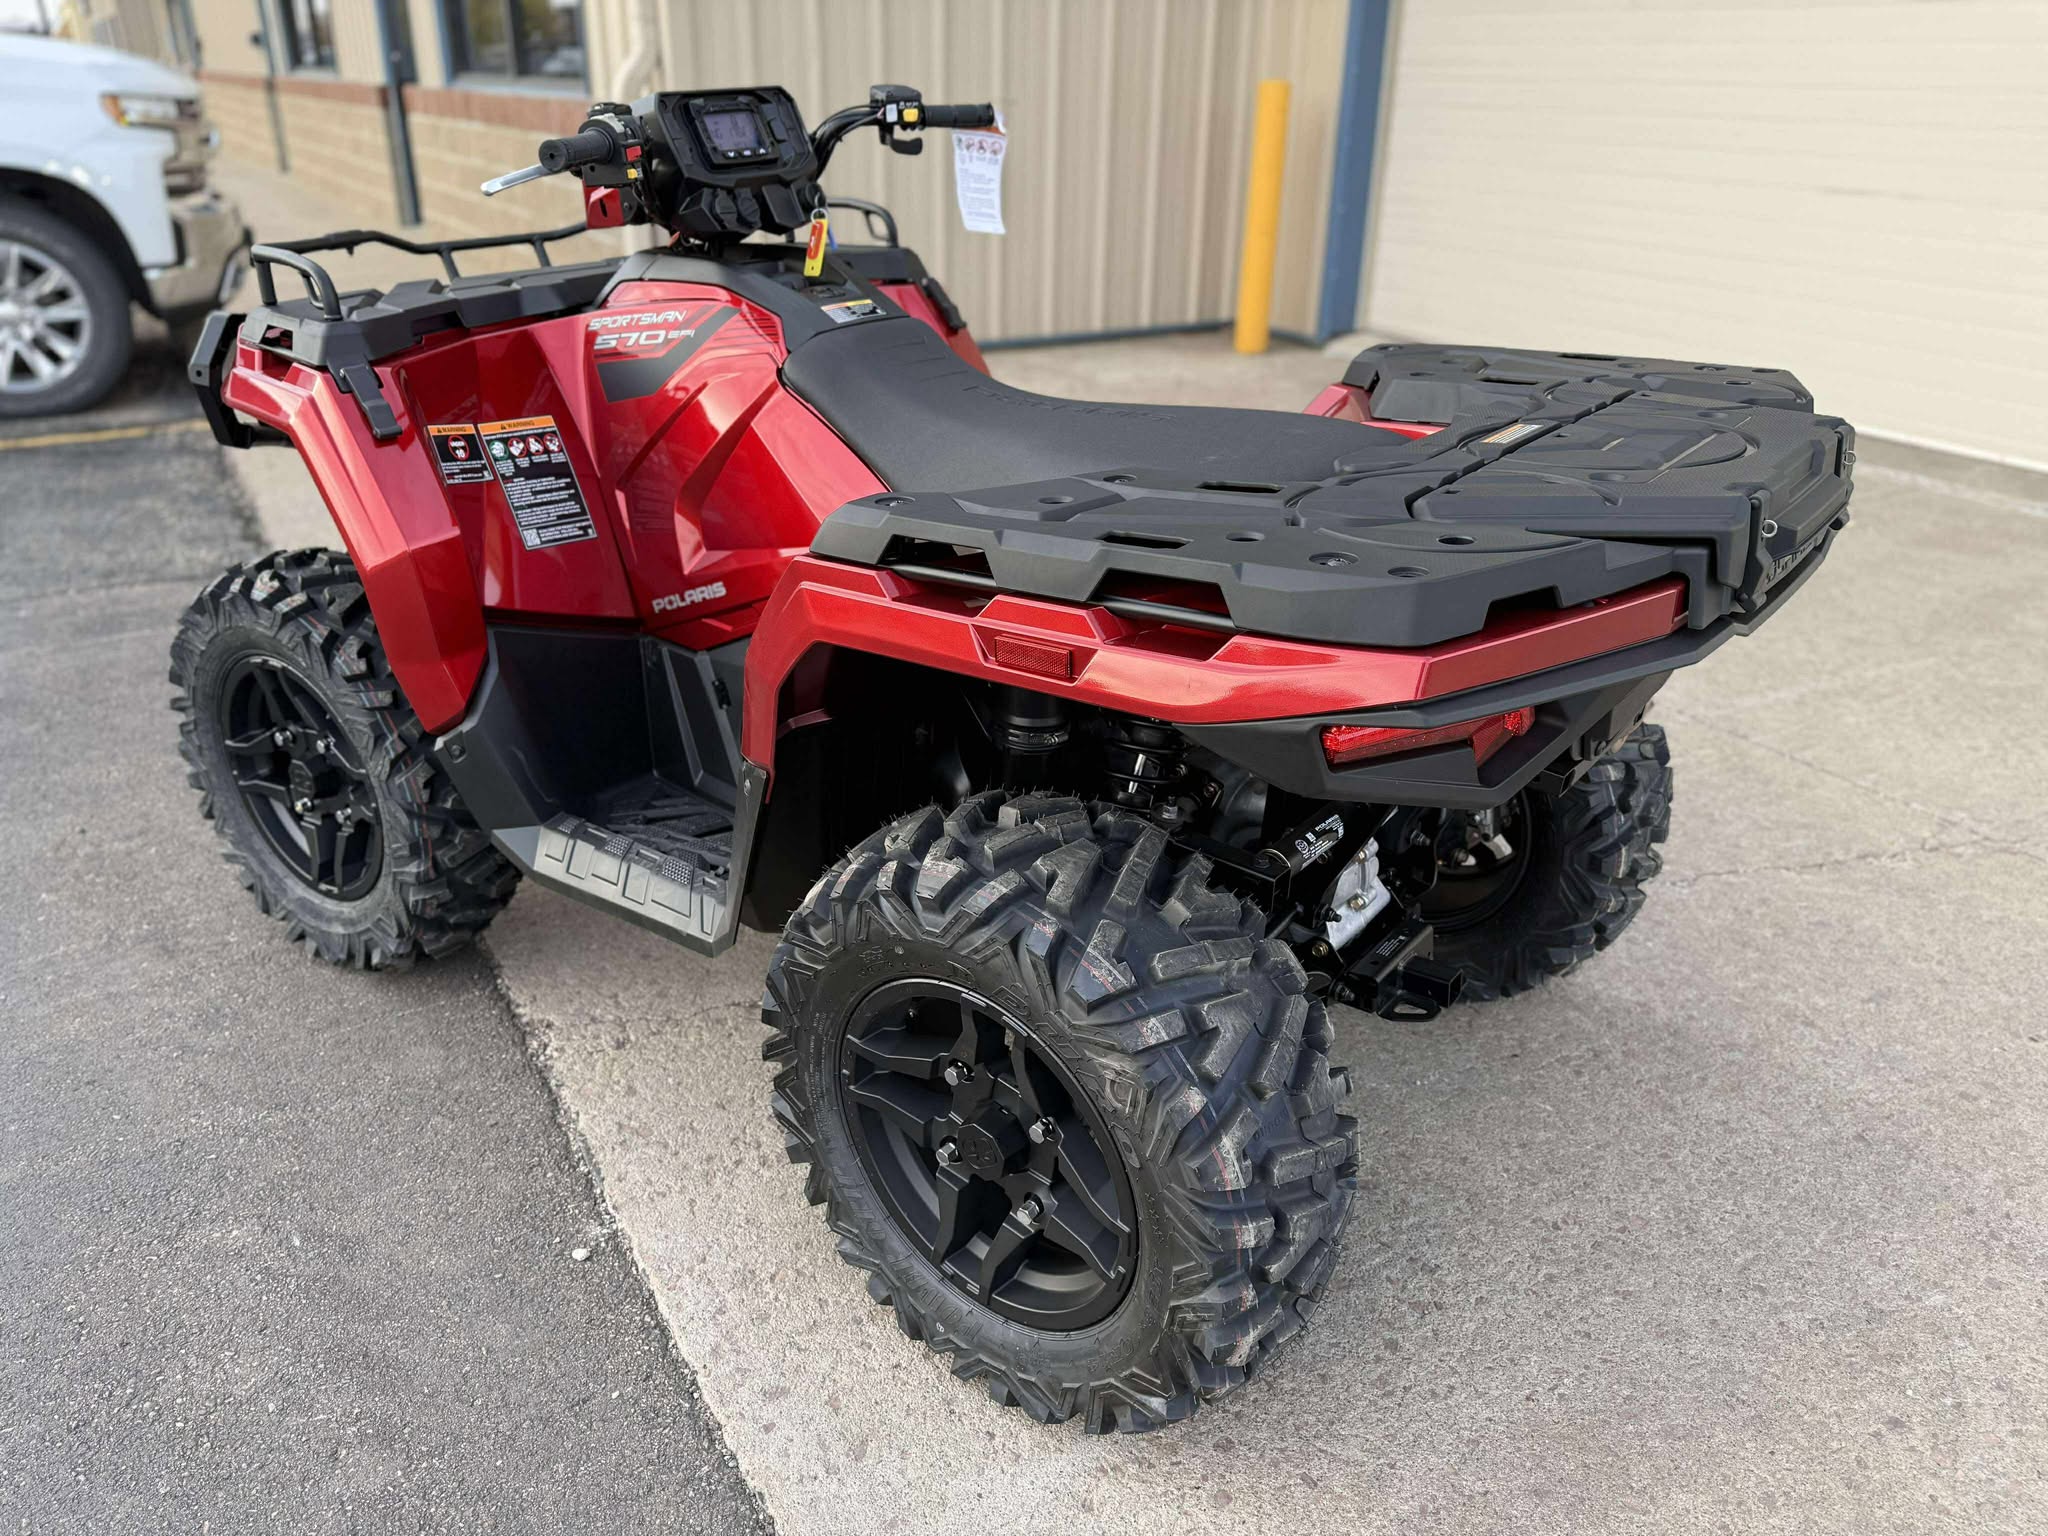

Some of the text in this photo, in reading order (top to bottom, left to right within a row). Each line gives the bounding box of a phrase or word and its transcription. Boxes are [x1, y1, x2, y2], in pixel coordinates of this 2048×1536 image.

[588, 310, 687, 331] SPORTSMAN
[593, 329, 696, 350] 570 EFI
[508, 420, 535, 429] WARNING
[652, 581, 727, 613] POLARIS
[991, 985, 1141, 1168] DURO
